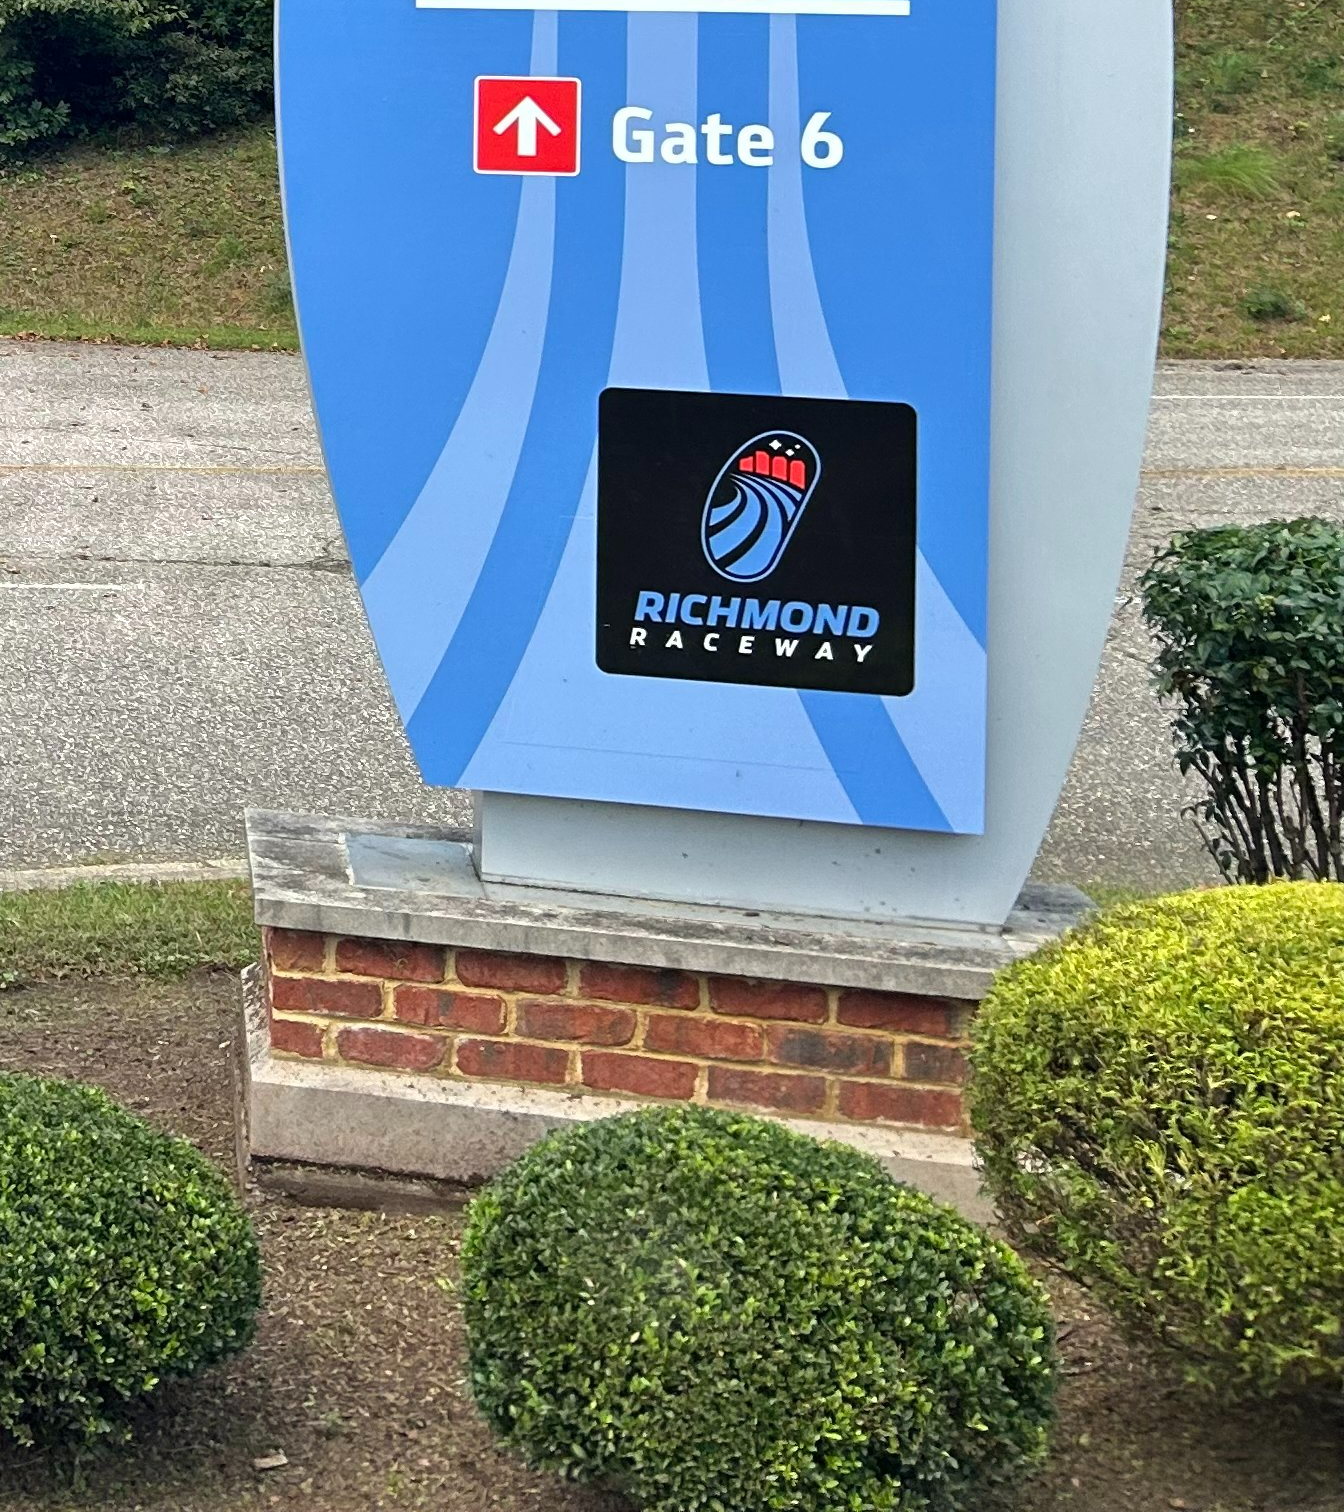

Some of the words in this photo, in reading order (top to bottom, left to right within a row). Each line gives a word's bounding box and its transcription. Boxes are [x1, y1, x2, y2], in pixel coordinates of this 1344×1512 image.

[612, 105, 775, 168] Gate
[800, 111, 845, 169] 6
[633, 590, 881, 639] RICHMOND
[629, 627, 872, 663] RACEWAY
